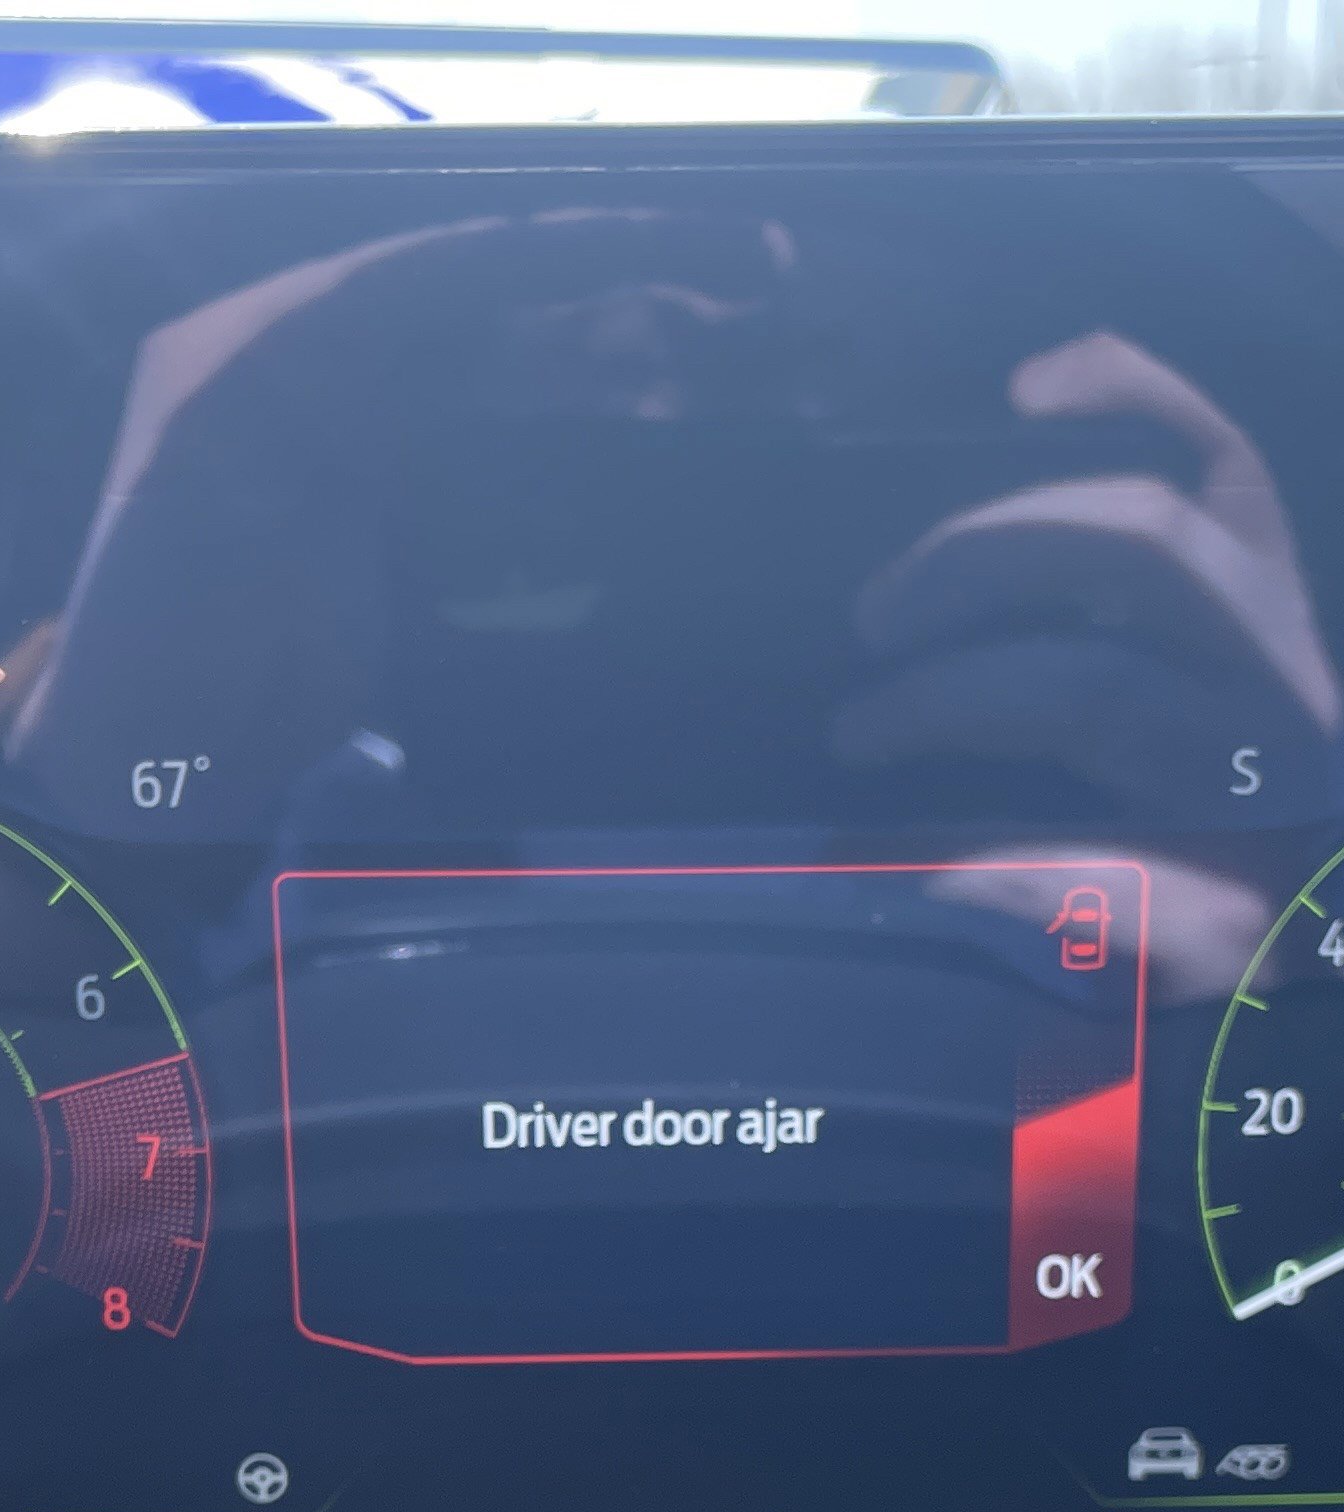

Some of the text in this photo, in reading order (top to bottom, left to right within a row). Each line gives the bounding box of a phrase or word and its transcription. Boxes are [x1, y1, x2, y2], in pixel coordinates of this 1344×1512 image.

[1229, 747, 1263, 797] S
[75, 972, 106, 1021] 6
[481, 1098, 825, 1154] Driver door ajar
[1241, 1087, 1305, 1136] 20
[136, 1132, 163, 1182] 7
[1036, 1253, 1104, 1300] OK
[102, 1285, 133, 1333] 8
